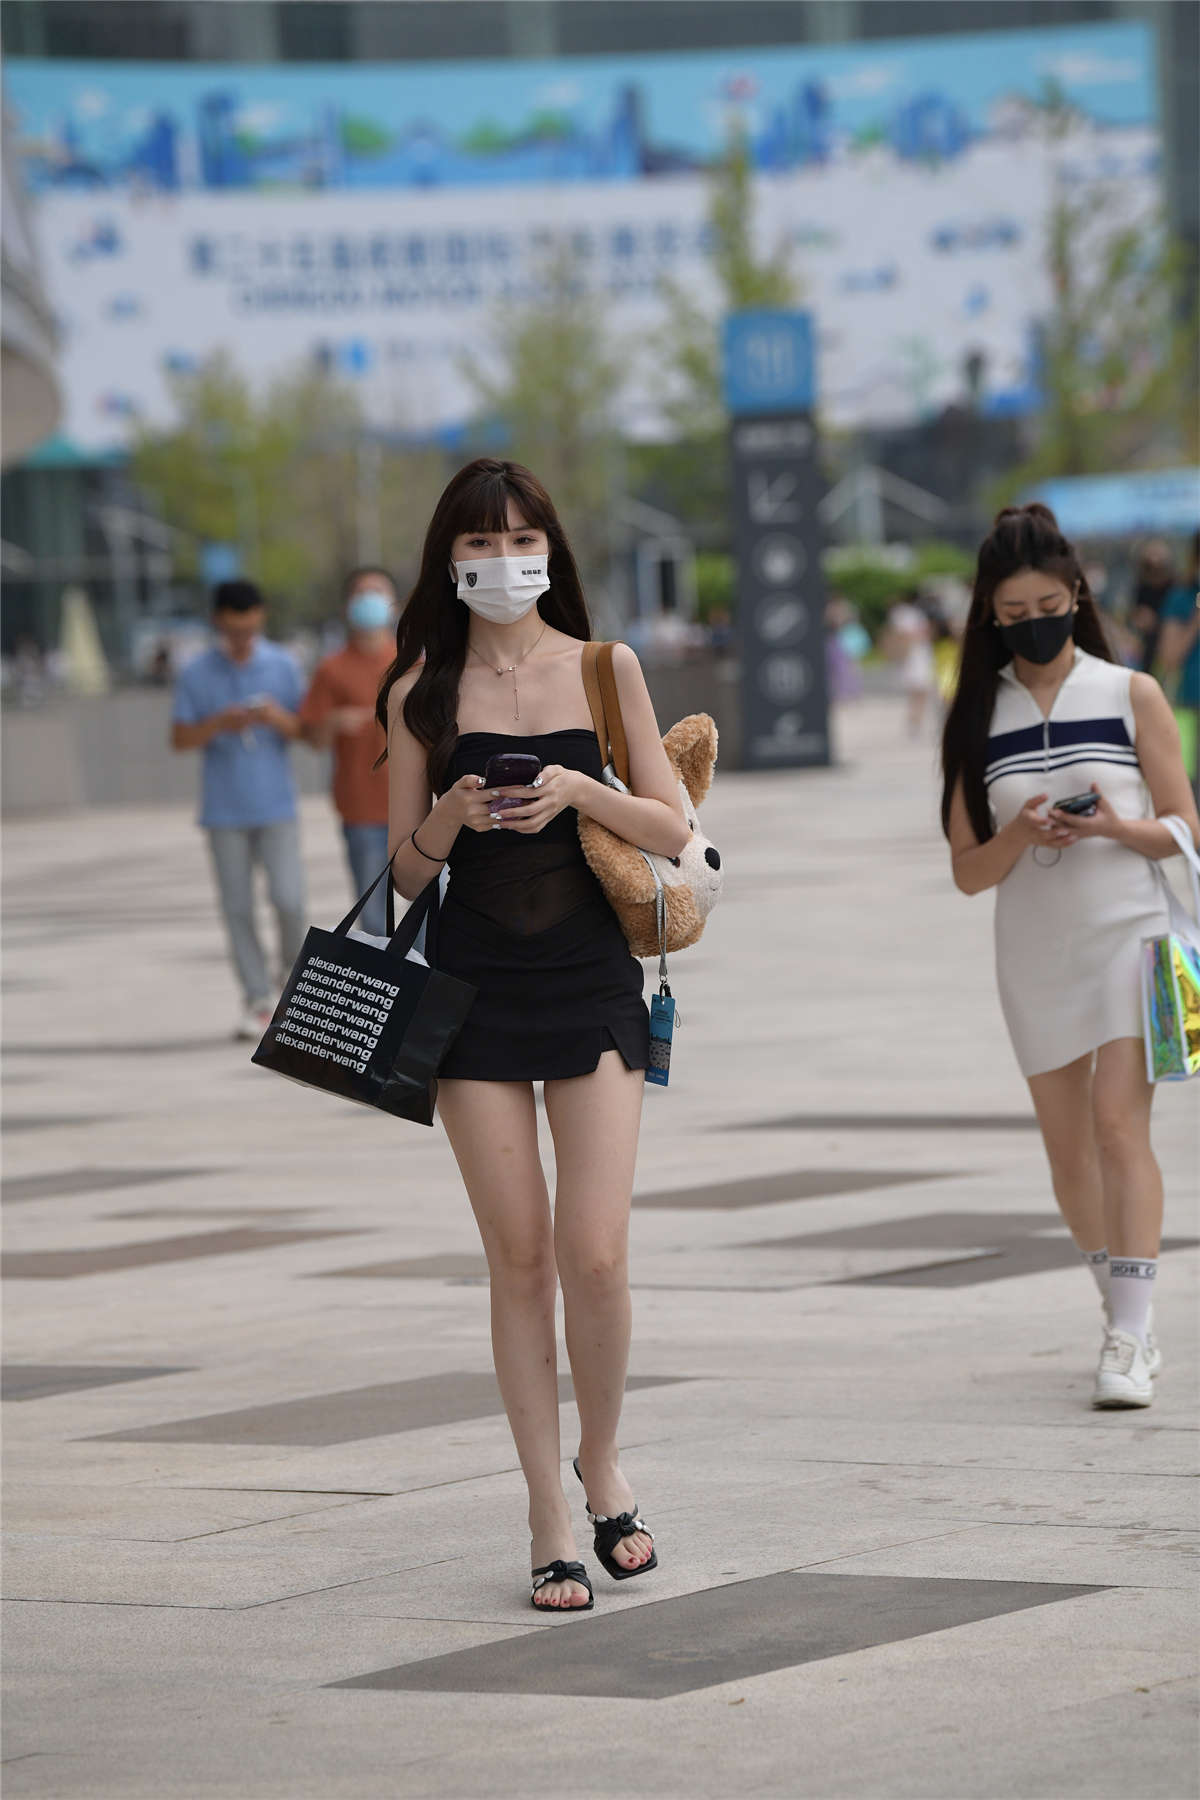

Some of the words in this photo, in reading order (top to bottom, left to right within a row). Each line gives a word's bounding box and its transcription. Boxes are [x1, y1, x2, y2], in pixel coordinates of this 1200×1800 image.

[302, 968, 393, 1009] alexanderwang
[308, 956, 399, 996] alexanderwang
[290, 993, 383, 1036] alexanderwang
[296, 981, 388, 1023] alexanderwang
[280, 1019, 372, 1061] alexanderwang
[285, 1006, 378, 1049] alexanderwang
[275, 1032, 366, 1074] alexanderwang
